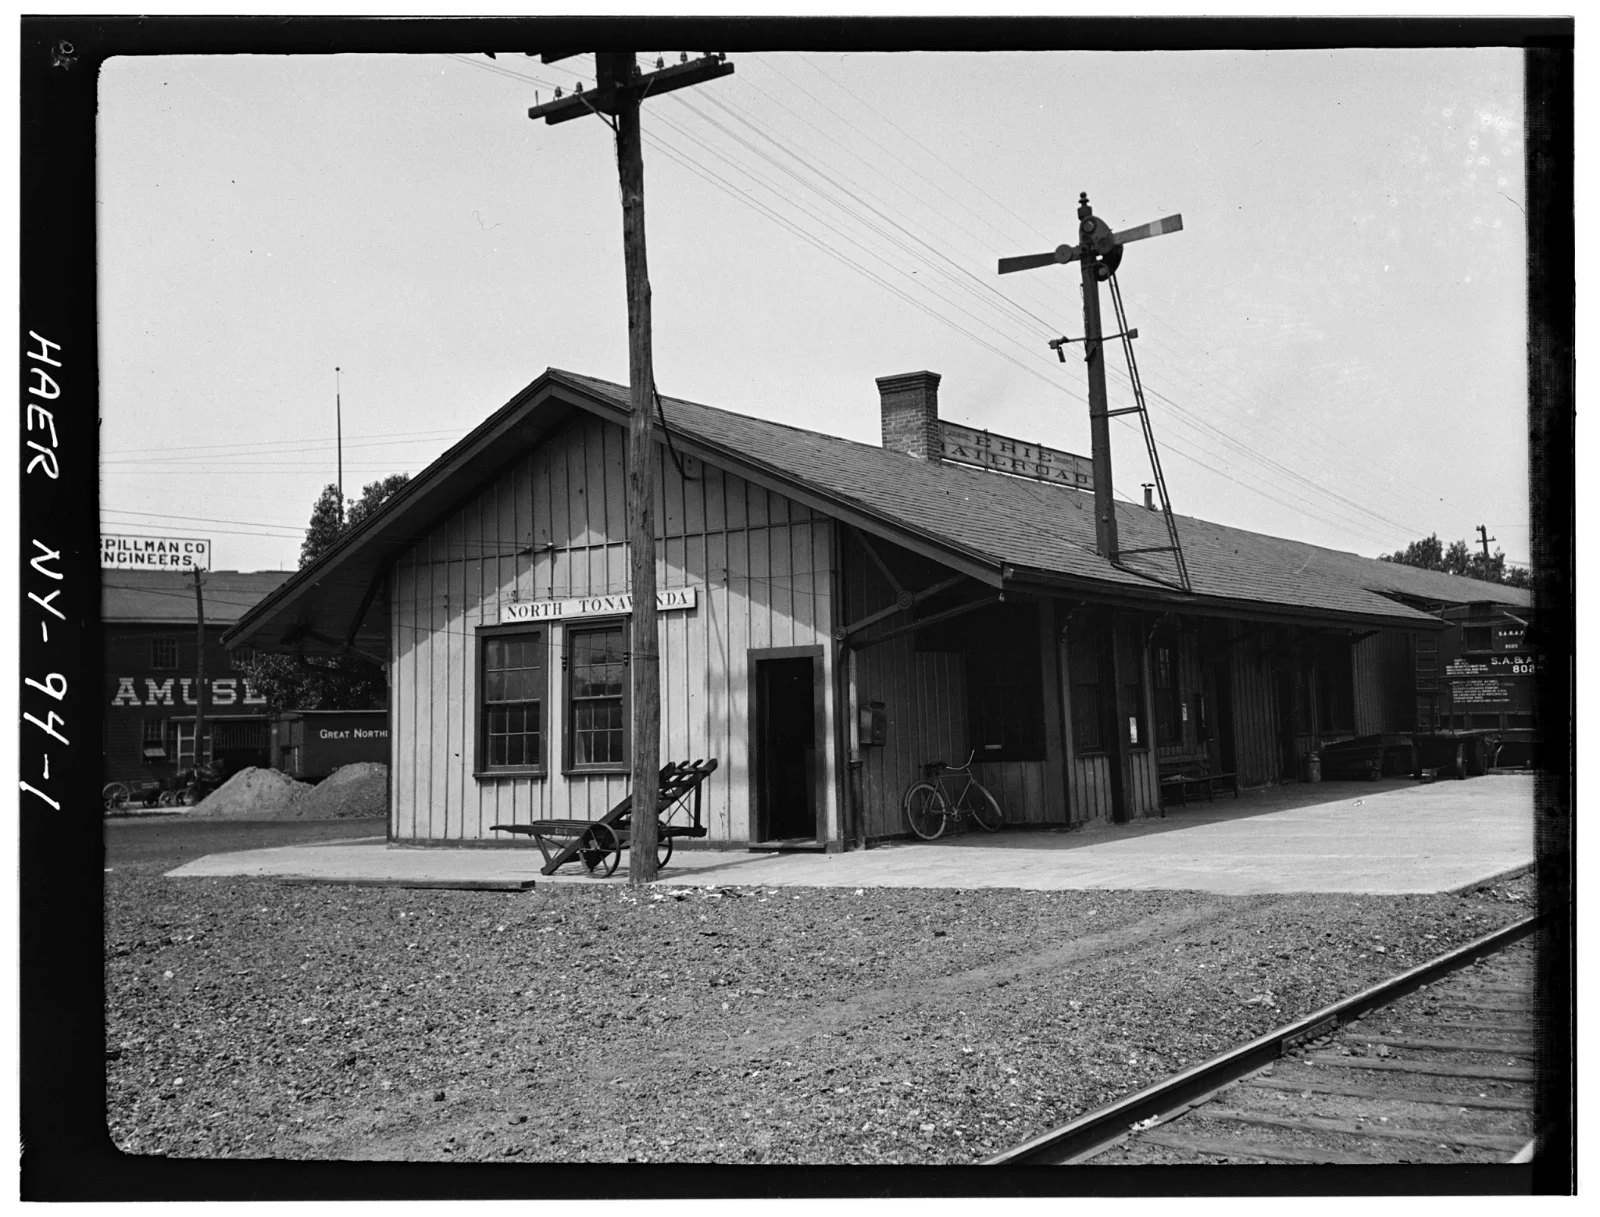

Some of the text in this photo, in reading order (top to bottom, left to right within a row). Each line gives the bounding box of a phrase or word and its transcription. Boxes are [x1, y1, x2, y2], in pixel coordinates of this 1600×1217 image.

[974, 435, 1052, 463] ERIE
[184, 542, 205, 554] CO
[507, 591, 688, 619] NORTH TONANDA
[319, 728, 350, 739] GREAT
